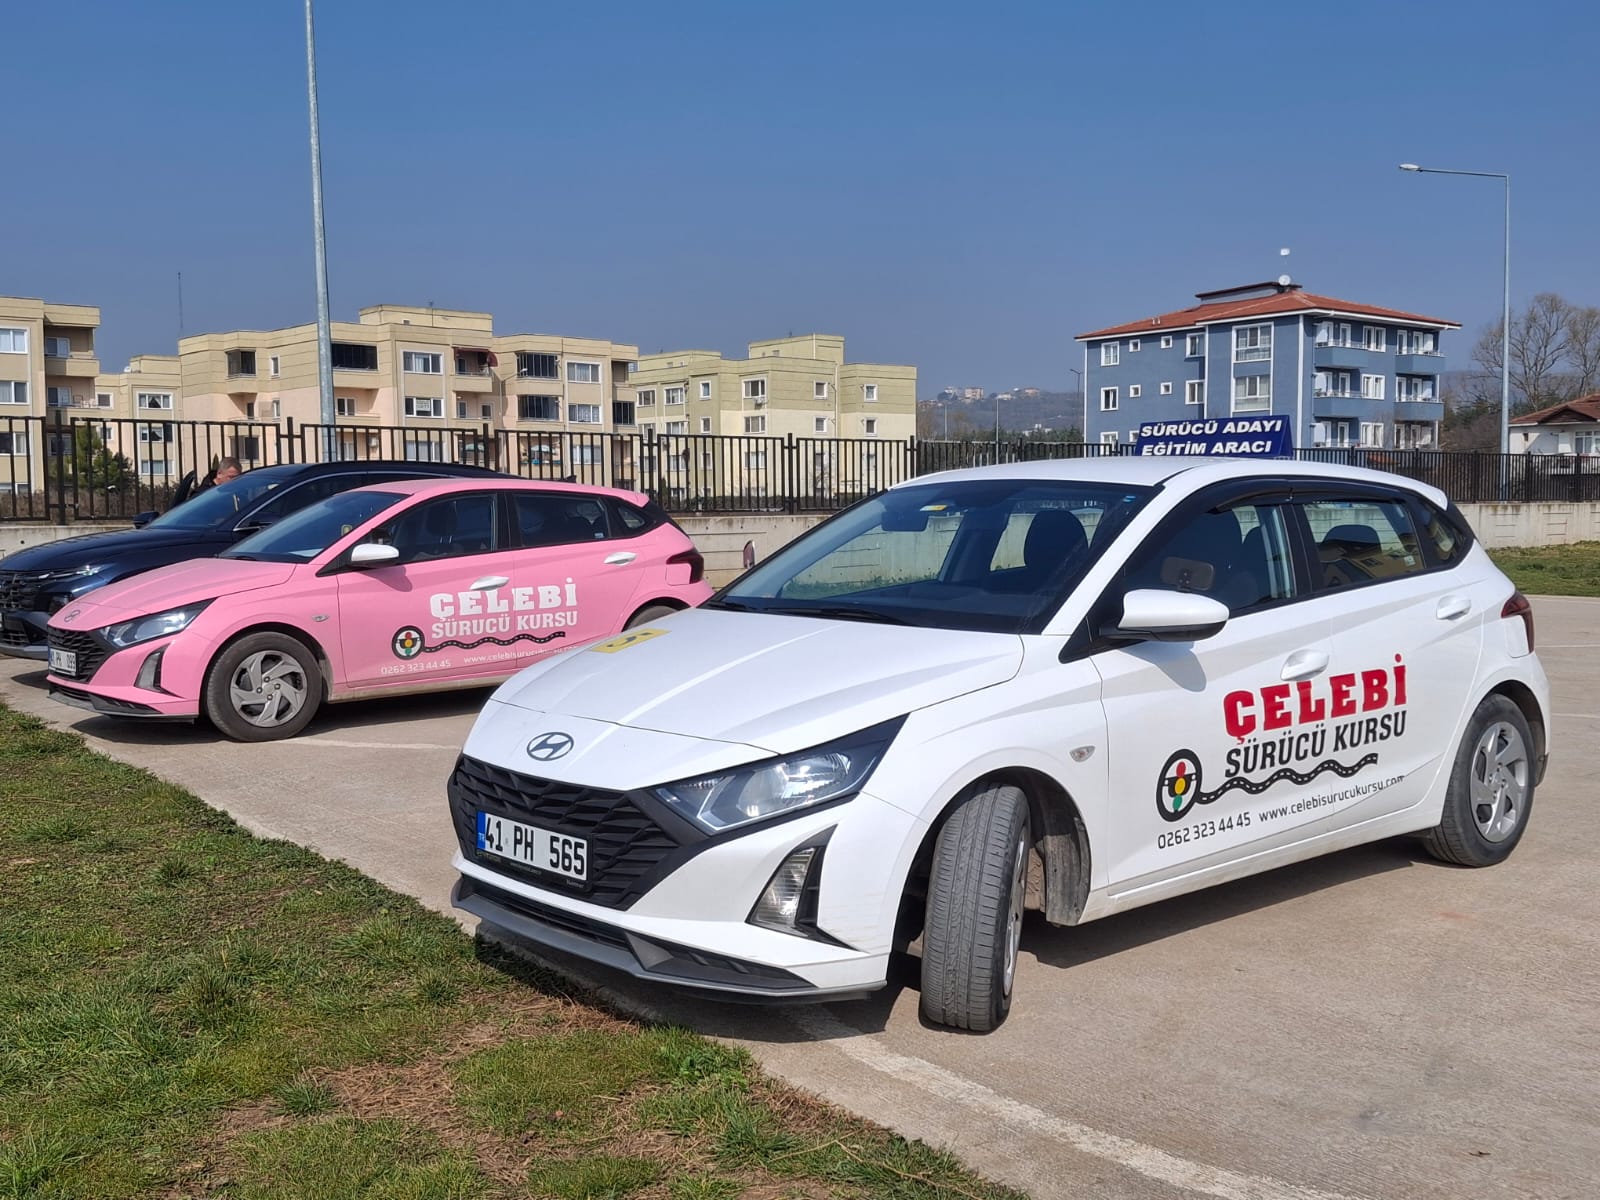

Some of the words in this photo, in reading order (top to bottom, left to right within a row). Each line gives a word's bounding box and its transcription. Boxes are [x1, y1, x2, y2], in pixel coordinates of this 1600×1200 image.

[1141, 420, 1218, 437] SÜRÜCÜ
[1222, 420, 1282, 434] ADAYI
[1142, 441, 1206, 456] EĞİTİM
[1211, 440, 1272, 453] ARACI
[430, 577, 577, 621] ÇELEBİ
[517, 611, 578, 631] KURSU
[381, 665, 405, 675] 0262
[407, 662, 425, 672] 323
[1223, 653, 1407, 744] ÇELEBİ
[1225, 724, 1326, 778] SÜRÜCÜ
[1333, 710, 1407, 752] KURSU
[485, 817, 503, 852] 41
[513, 825, 534, 861] PH
[549, 835, 585, 875] 565
[1157, 828, 1191, 849] 0262
[1193, 821, 1216, 840] 323
[1218, 815, 1234, 832] 44
[1236, 811, 1251, 828] 45
